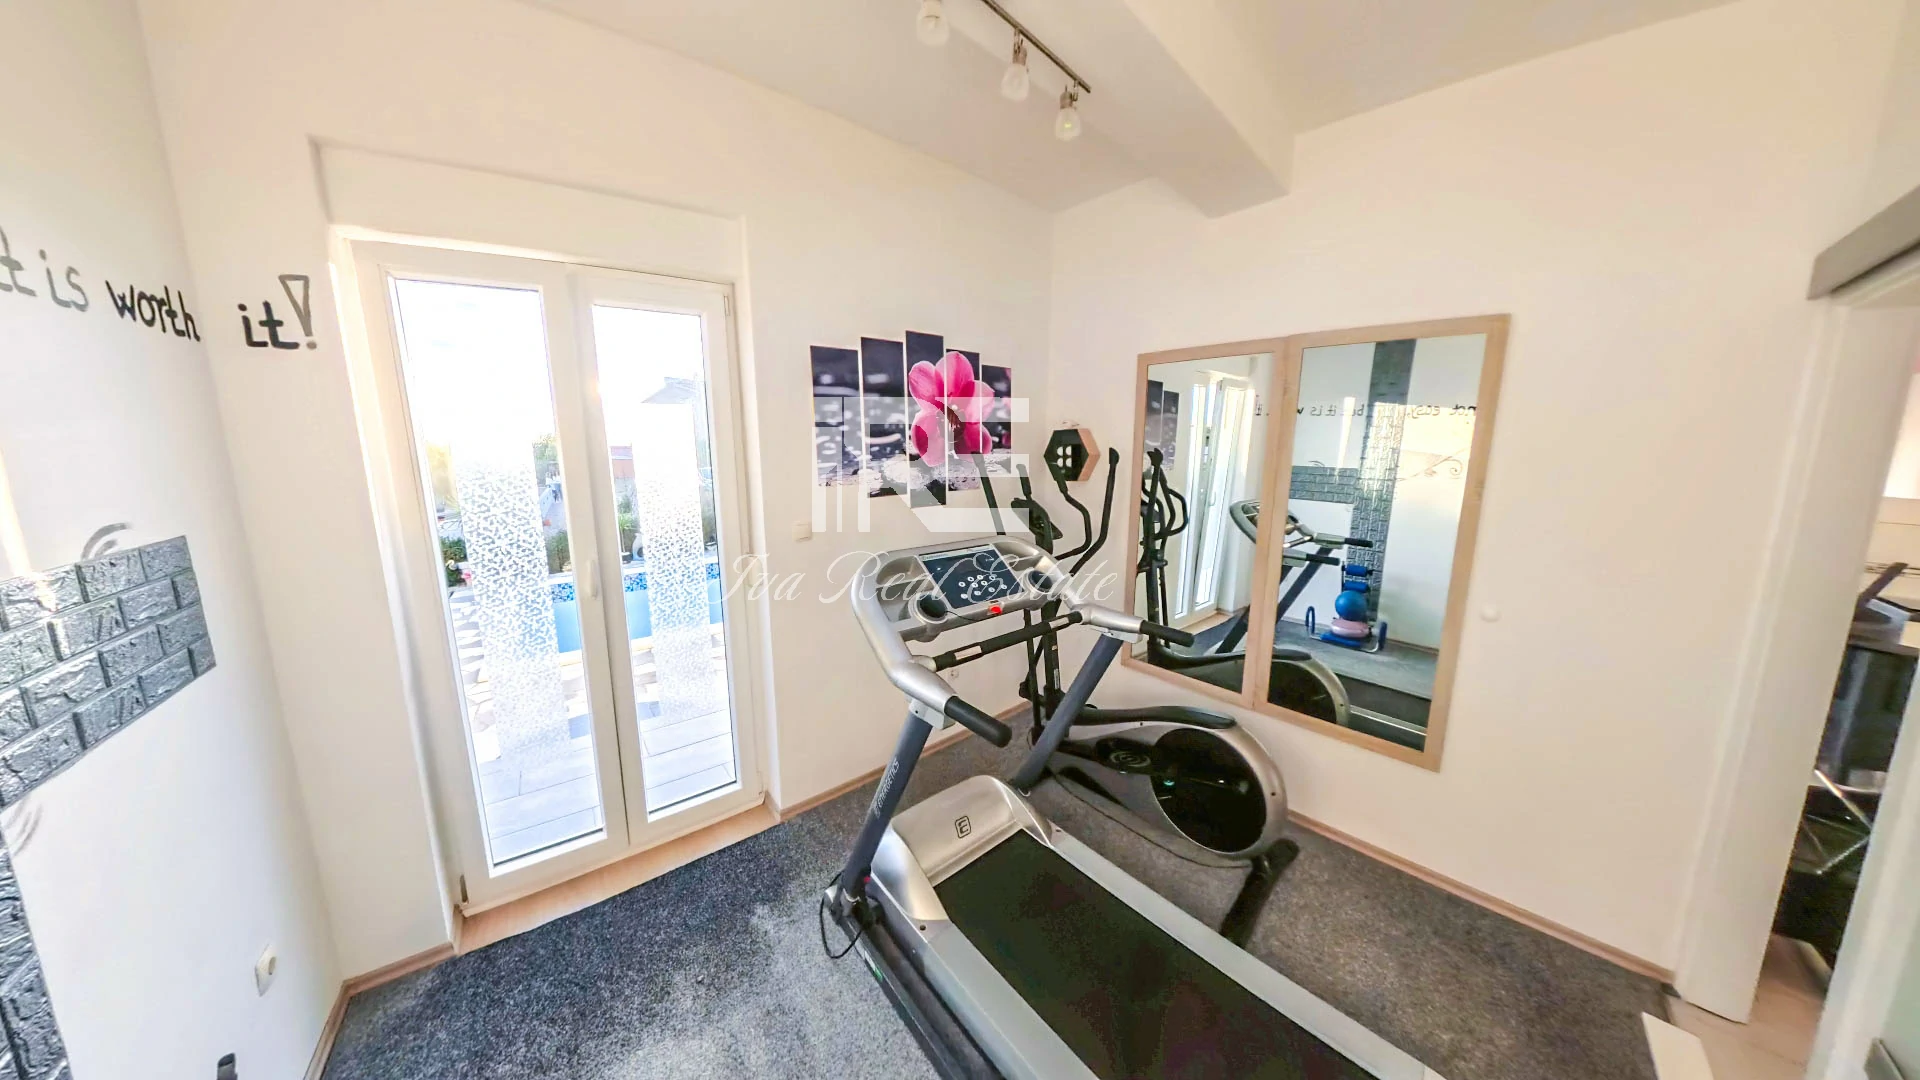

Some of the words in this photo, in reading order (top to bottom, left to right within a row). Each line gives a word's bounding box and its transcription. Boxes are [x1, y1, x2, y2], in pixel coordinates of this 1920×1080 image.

[0, 224, 37, 297] t
[38, 249, 89, 312] is
[104, 280, 200, 342] worth
[238, 274, 318, 349] it!
